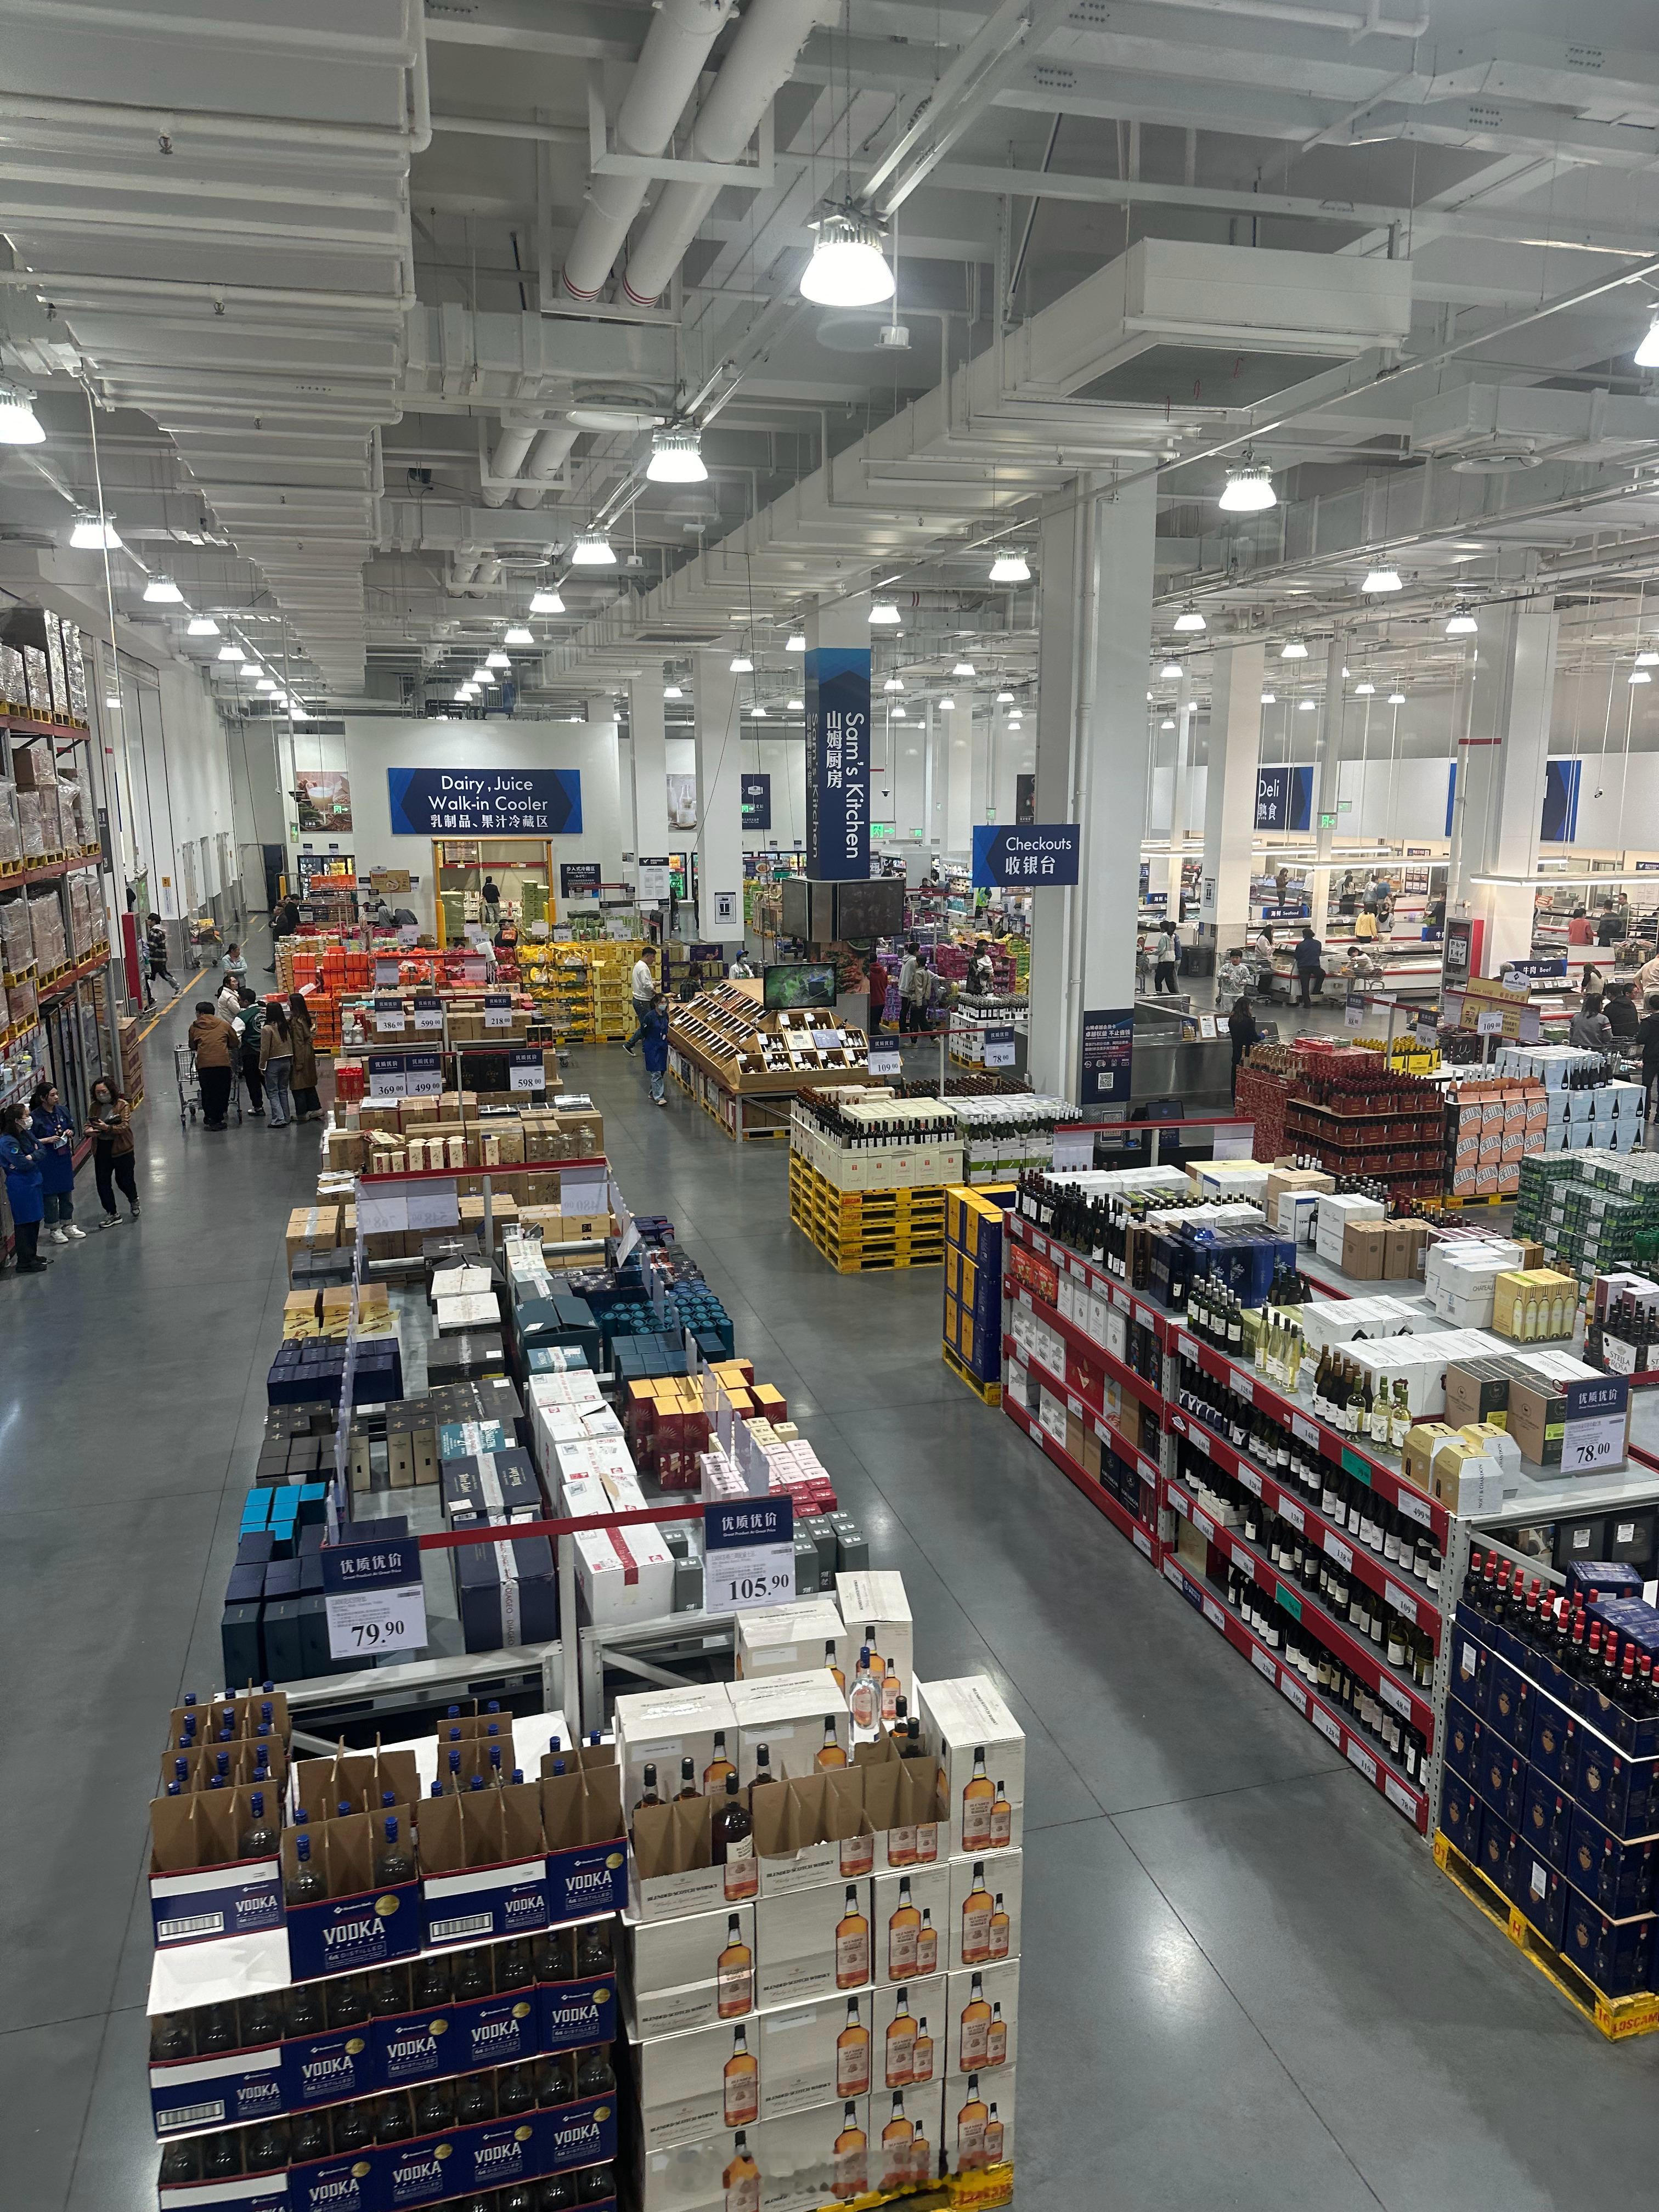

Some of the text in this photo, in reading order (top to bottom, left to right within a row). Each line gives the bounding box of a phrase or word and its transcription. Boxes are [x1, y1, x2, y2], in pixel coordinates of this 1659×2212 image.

[826, 710, 843, 788] 山姆厨房
[494, 776, 533, 791] Juice
[845, 712, 865, 859] Sam's Kitchen
[1259, 778, 1280, 797] Deli
[428, 795, 548, 811] Walk-in Cooler
[1258, 803, 1277, 821] 熟食
[430, 814, 549, 828] 乳制品、果汁冷藏区
[1006, 837, 1072, 851] Checkouts
[1005, 855, 1056, 875] 收银台
[1523, 966, 1537, 974] 牛肉
[1483, 1022, 1501, 1031] 109.00
[878, 1063, 898, 1072] 109.00
[993, 1054, 1009, 1063] 78.00
[378, 1086, 404, 1095] 369.00
[415, 1083, 440, 1092] 499.00
[518, 1078, 541, 1087] 598.00
[1610, 1351, 1630, 1366] STELLA
[1611, 1359, 1628, 1373] ROSA
[1578, 1388, 1618, 1405] 优质优价
[1576, 1442, 1610, 1464] 78.00
[721, 1511, 777, 1531] 优质优价
[340, 1553, 402, 1575] 优质优价
[729, 1573, 789, 1601] 105.90
[505, 1588, 514, 1613] DIAGEO
[351, 1620, 405, 1646] 79.90
[507, 1620, 515, 1646] DIAGEO
[766, 1860, 834, 1878] BLENDED SCOTCH WHISKY
[566, 1870, 612, 1892] VODKA
[647, 1891, 672, 1902] BLENDED
[673, 1887, 695, 1897] SCOTCH
[696, 1883, 718, 1892] WHISKY
[235, 1895, 278, 1913] VODKA
[505, 1895, 545, 1913] VODKA
[323, 1917, 386, 1945] VODKA
[1513, 1921, 1521, 1937] H
[340, 1944, 383, 1959] DISTILLED
[763, 1972, 831, 1991] BLENDED SCOTCH WHISKY
[552, 2005, 599, 2024] VODKA
[642, 2002, 712, 2023] BLENDED SCOTCH WHISKY
[471, 2019, 520, 2041] VODKA
[1612, 2013, 1659, 2034] LOSCAM
[387, 2036, 437, 2059] VODKA
[302, 2055, 354, 2079] VODKA
[237, 2083, 280, 2102] VODKA
[765, 2082, 831, 2102] BLENDED SCOTCH WHISKY
[650, 2111, 719, 2133] BLENDED SCOTCH WHISKY
[554, 2123, 601, 2146] VODKA
[474, 2141, 523, 2164] VODKA
[392, 2160, 443, 2183] VODKA
[308, 2177, 360, 2202] VODKA
